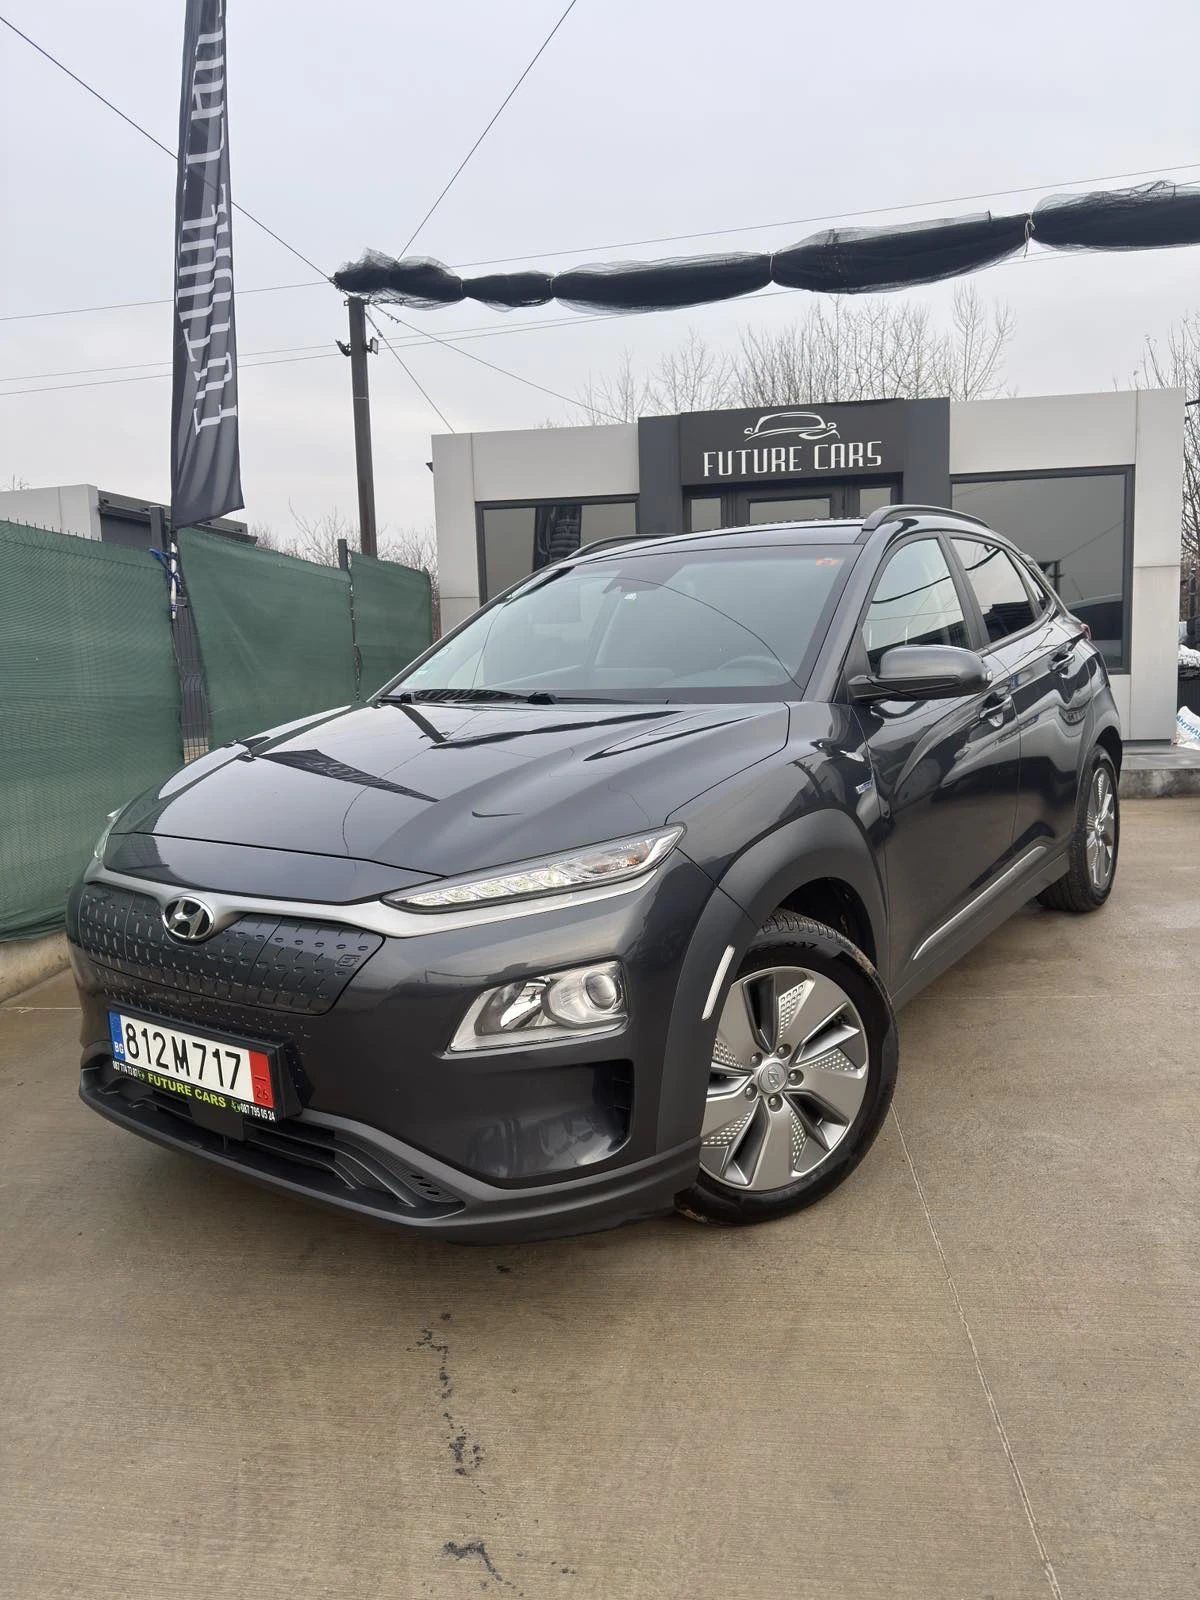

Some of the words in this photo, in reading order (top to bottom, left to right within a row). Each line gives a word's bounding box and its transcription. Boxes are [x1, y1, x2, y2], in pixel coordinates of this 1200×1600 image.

[703, 446, 802, 477] FUTURE
[813, 441, 882, 470] CARS
[114, 1041, 124, 1054] BG
[125, 1023, 241, 1090] 812M717
[147, 1072, 192, 1096] FUTURE
[194, 1088, 227, 1108] CARS
